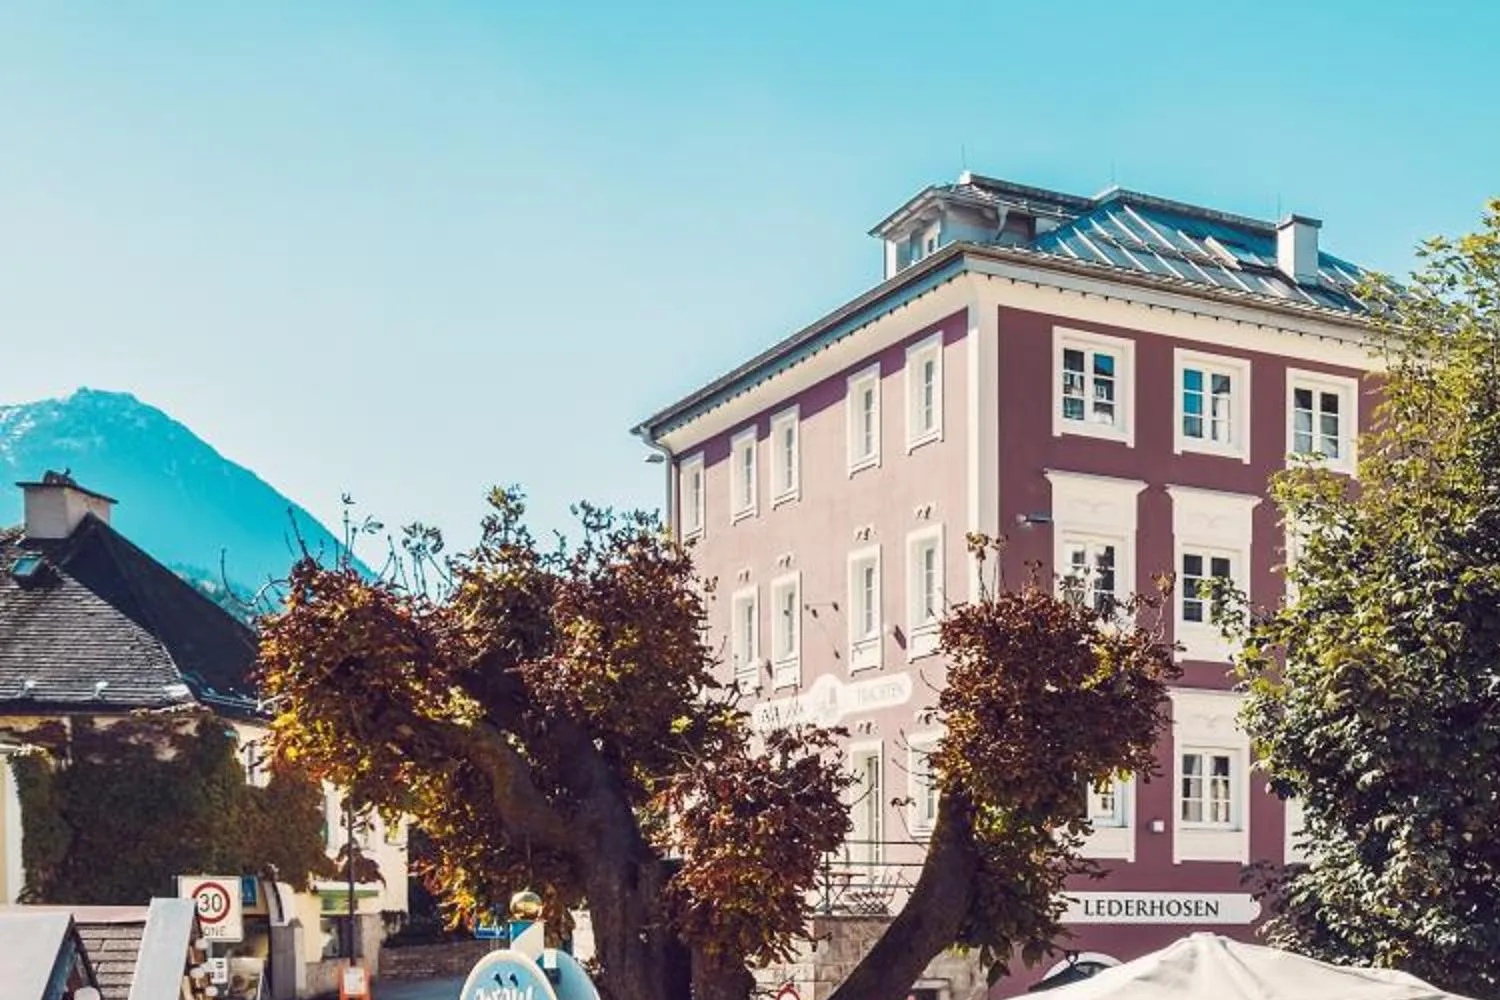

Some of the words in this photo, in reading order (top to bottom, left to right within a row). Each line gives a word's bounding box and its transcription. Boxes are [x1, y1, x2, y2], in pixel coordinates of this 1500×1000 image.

[199, 893, 223, 912] 30
[1084, 899, 1219, 917] LEDERHOSEN
[203, 925, 226, 937] ONE
